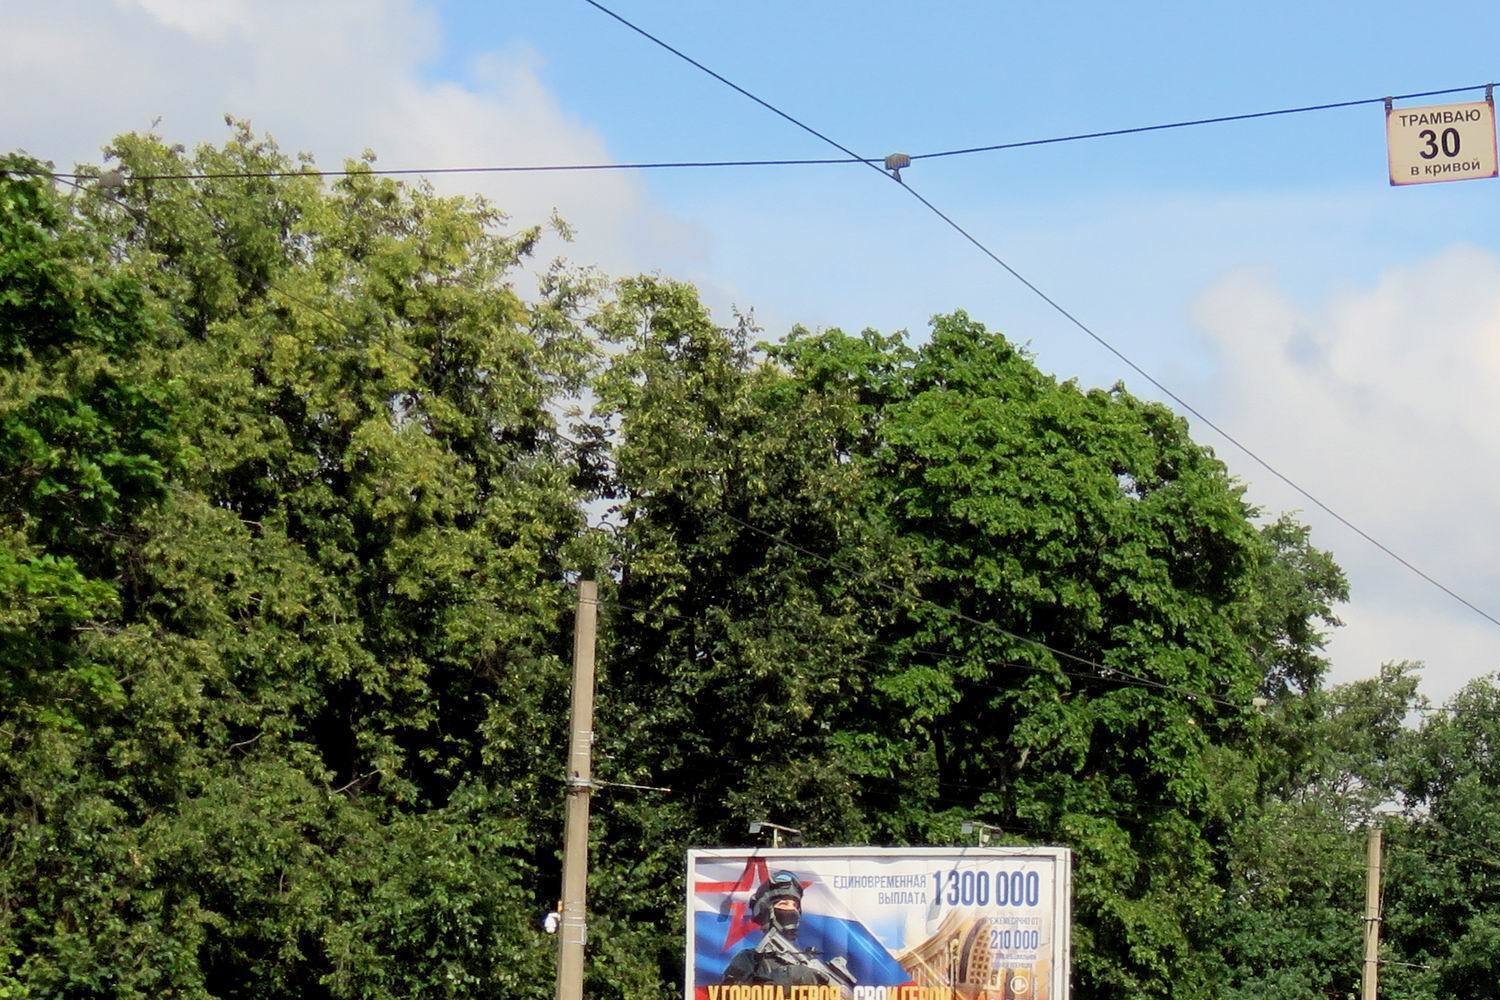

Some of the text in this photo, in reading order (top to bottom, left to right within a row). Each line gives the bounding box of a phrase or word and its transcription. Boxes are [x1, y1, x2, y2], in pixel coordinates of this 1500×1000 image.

[1399, 109, 1481, 127] ТРАМВАЮ
[1418, 127, 1461, 160] 30
[1410, 157, 1480, 176] в кривой
[833, 874, 926, 889] ЕДИНОВРЕМЕННАЯ
[878, 891, 927, 905] ВЫПЛАТА
